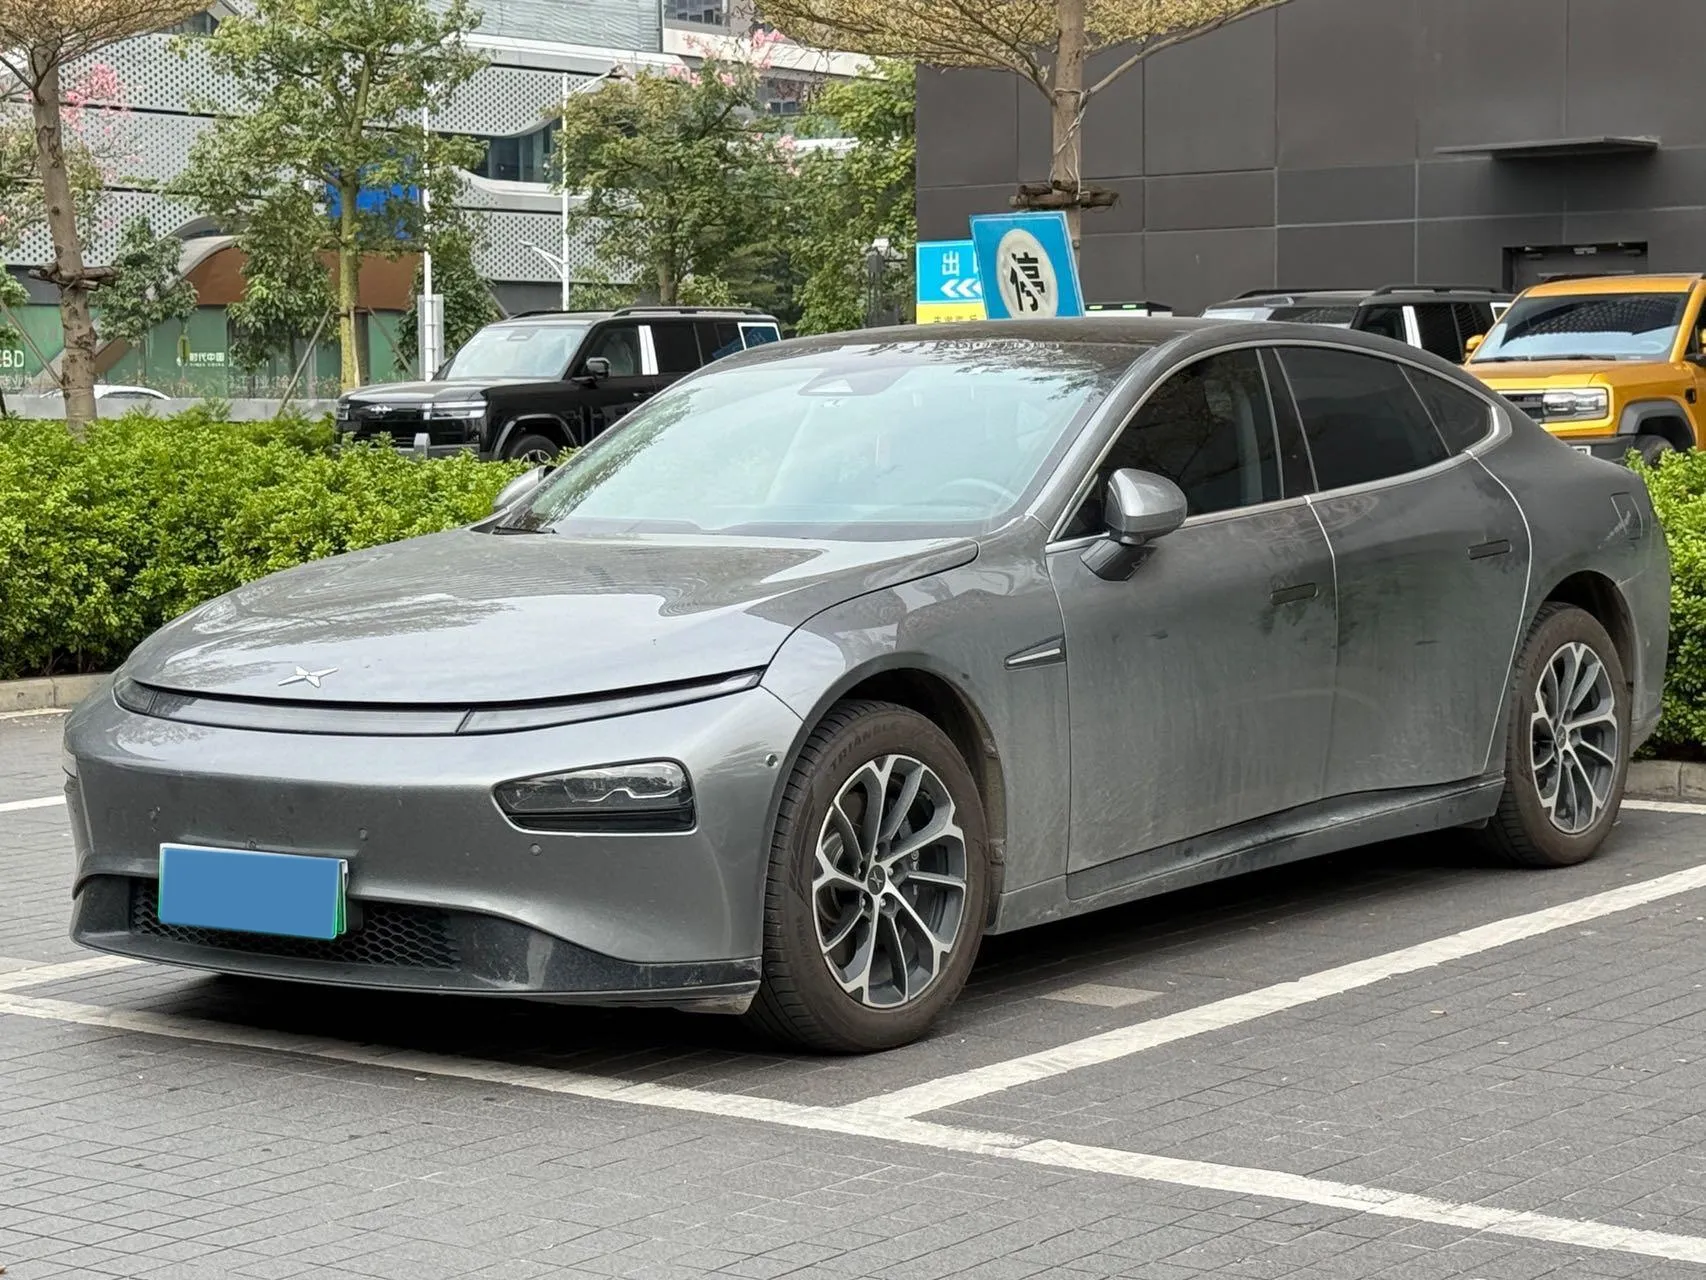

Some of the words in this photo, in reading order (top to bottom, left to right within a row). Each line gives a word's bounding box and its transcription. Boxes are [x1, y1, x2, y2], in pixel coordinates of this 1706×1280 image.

[1010, 252, 1045, 312] 停
[189, 352, 225, 362] 时代中国
